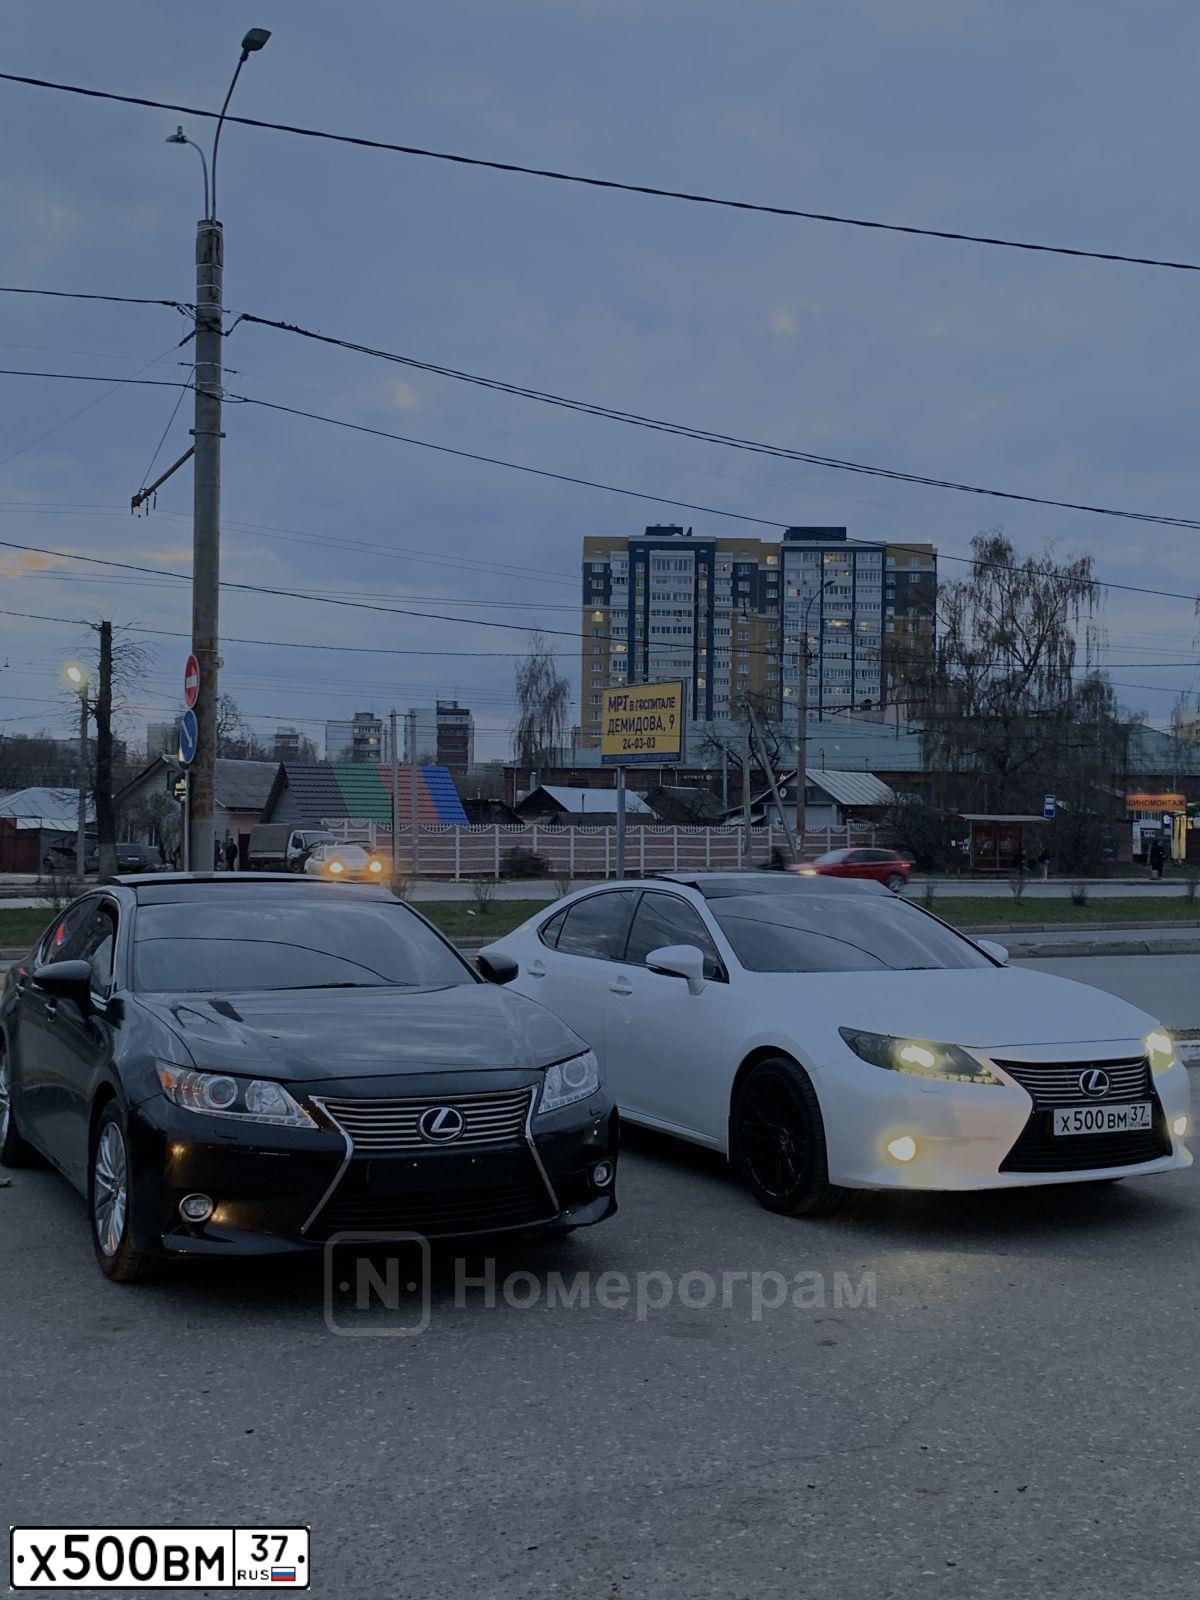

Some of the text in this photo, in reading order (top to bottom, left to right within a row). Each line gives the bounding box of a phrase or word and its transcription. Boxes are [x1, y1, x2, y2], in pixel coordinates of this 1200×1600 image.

[608, 695, 630, 713] МРТ
[635, 696, 676, 711] ГОСПИТАЛЕ
[607, 714, 675, 736] ДЕМИДОВА, 9
[622, 737, 656, 750] 24-03-03
[1061, 1106, 1146, 1132] Х500ВМ 37
